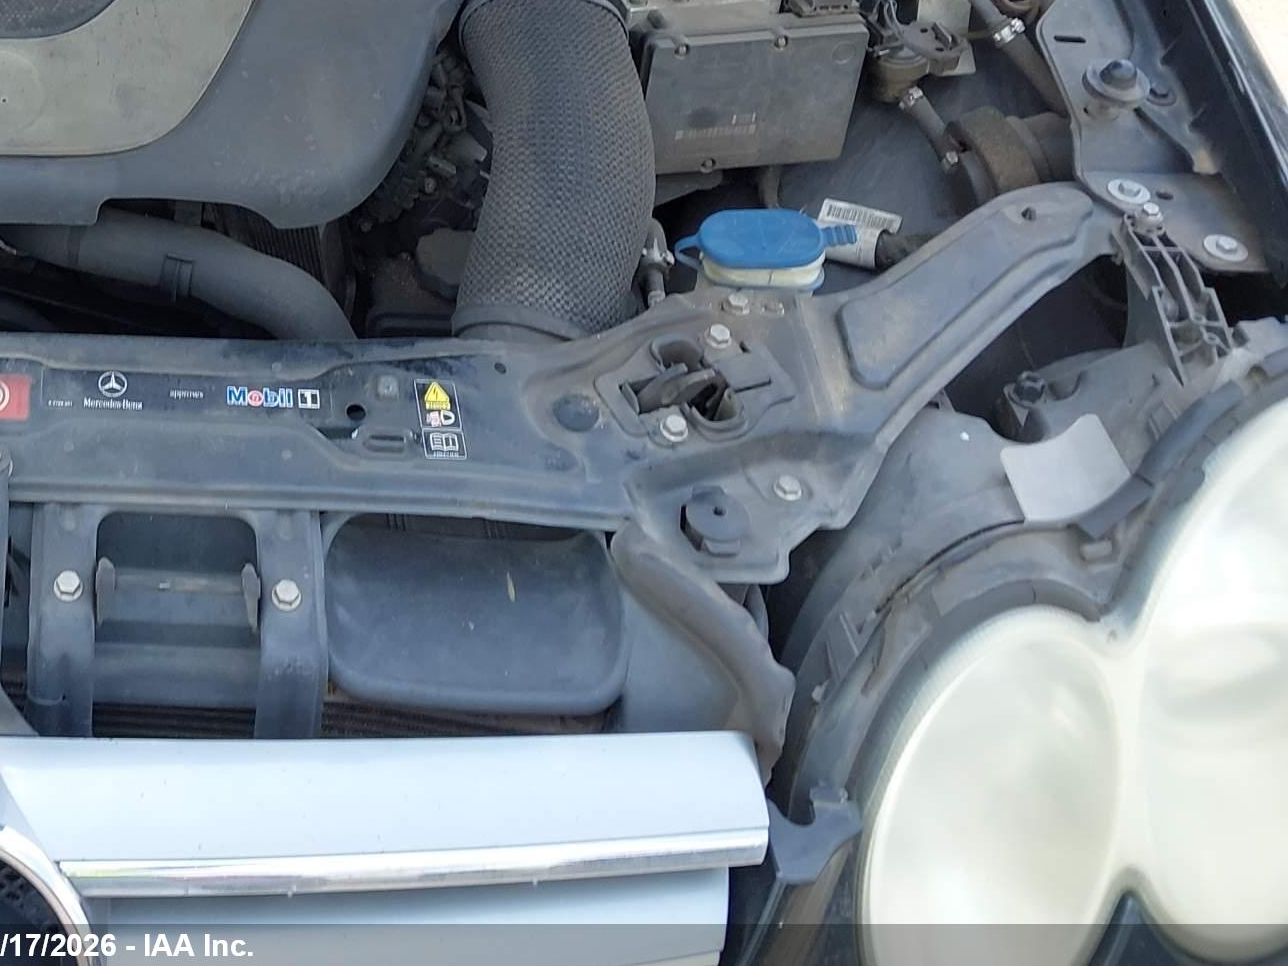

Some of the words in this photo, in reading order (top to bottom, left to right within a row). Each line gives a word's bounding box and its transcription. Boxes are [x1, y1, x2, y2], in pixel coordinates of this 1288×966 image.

[83, 396, 143, 411] Mercedes-Benz
[227, 386, 293, 408] Mobil
[301, 390, 316, 409] 1
